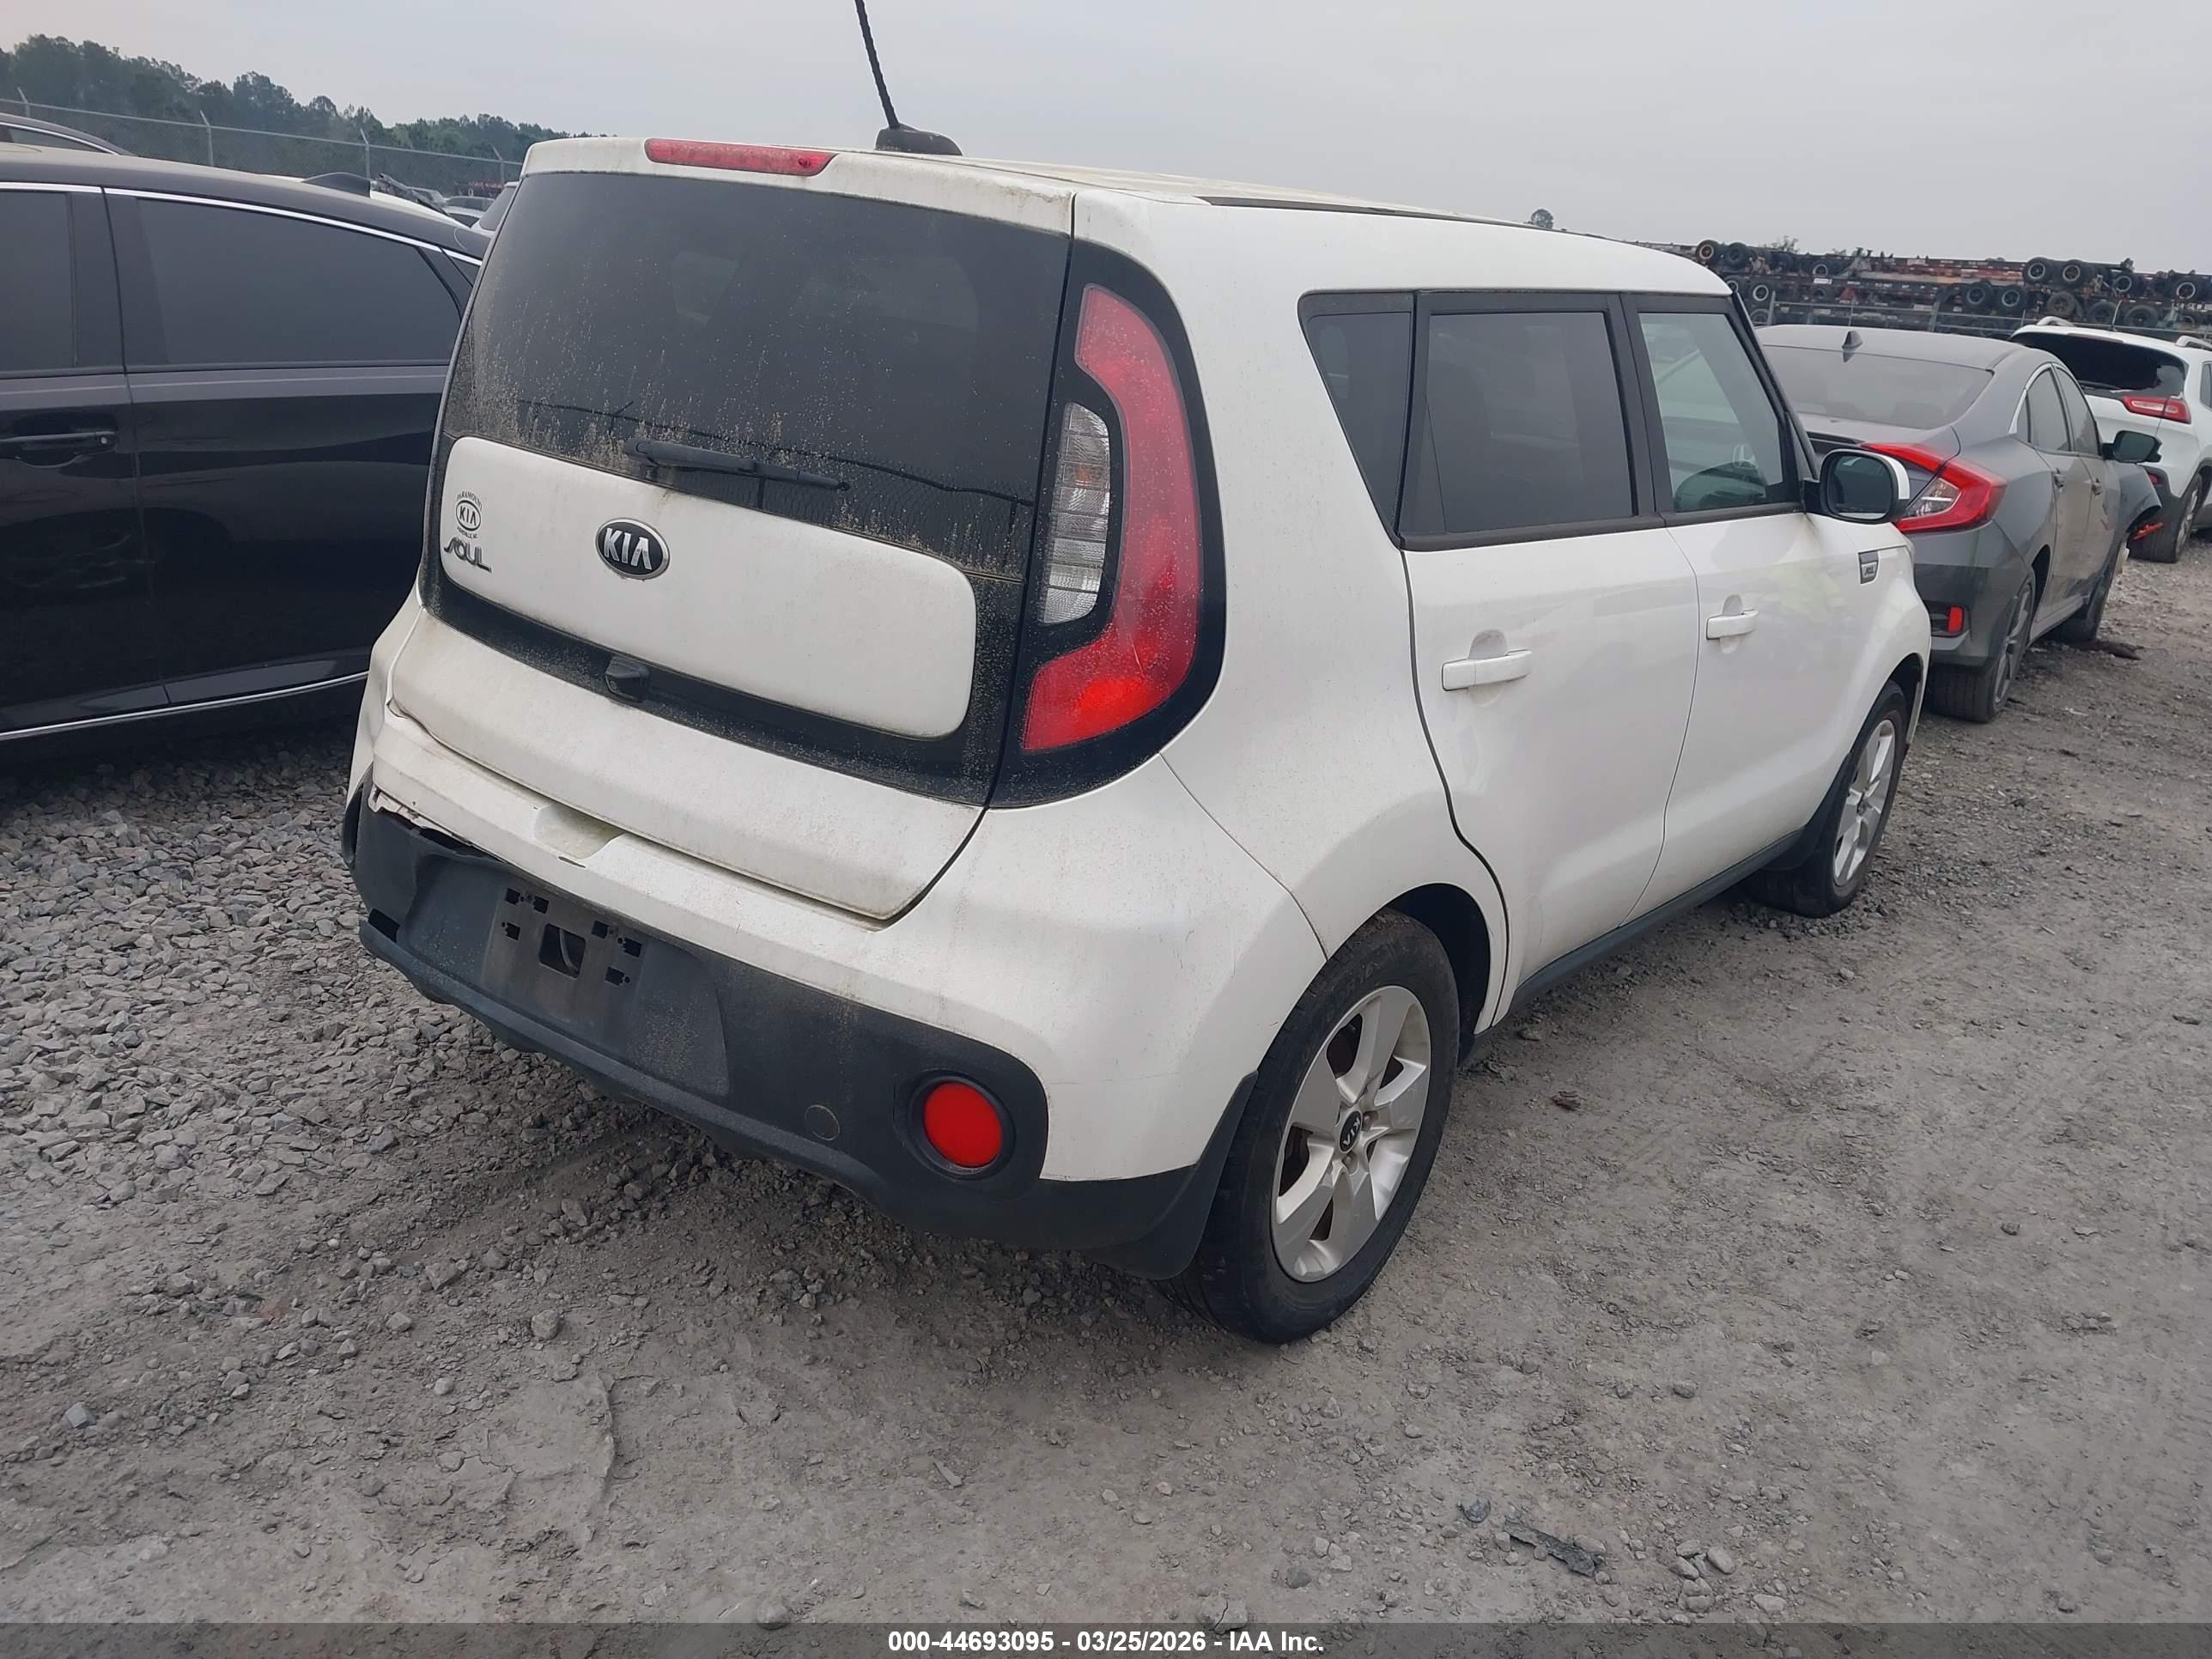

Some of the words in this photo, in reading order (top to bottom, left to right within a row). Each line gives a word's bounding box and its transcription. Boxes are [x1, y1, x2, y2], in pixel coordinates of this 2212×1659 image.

[459, 505, 477, 526] KIA
[603, 527, 653, 571] KIA
[1342, 1116, 1361, 1146] KIA
